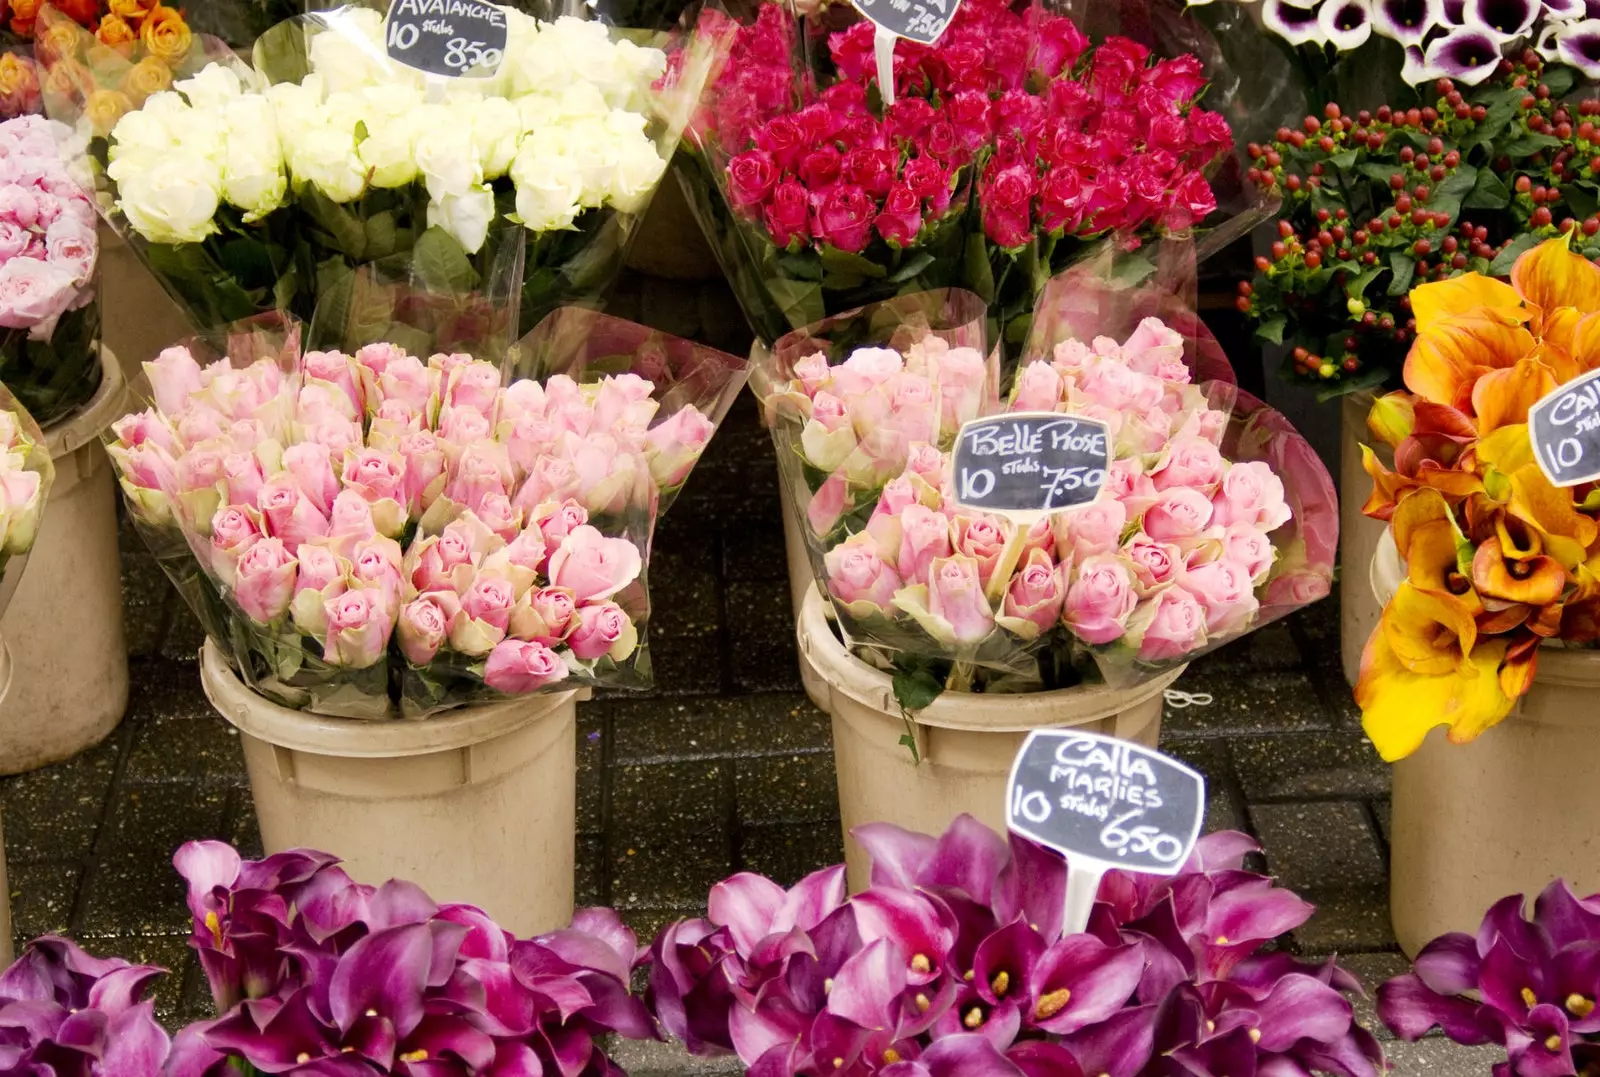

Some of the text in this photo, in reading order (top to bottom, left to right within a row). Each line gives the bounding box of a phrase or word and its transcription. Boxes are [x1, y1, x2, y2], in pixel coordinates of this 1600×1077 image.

[905, 4, 946, 37] 7.50
[388, 21, 420, 50] 10
[444, 37, 503, 73] 8.50
[1037, 420, 1106, 456] ROSE
[1546, 437, 1583, 474] 10
[961, 467, 996, 499] 10
[1040, 466, 1107, 509] 7.50
[1013, 785, 1051, 823] 10
[1100, 808, 1182, 862] 6.50
